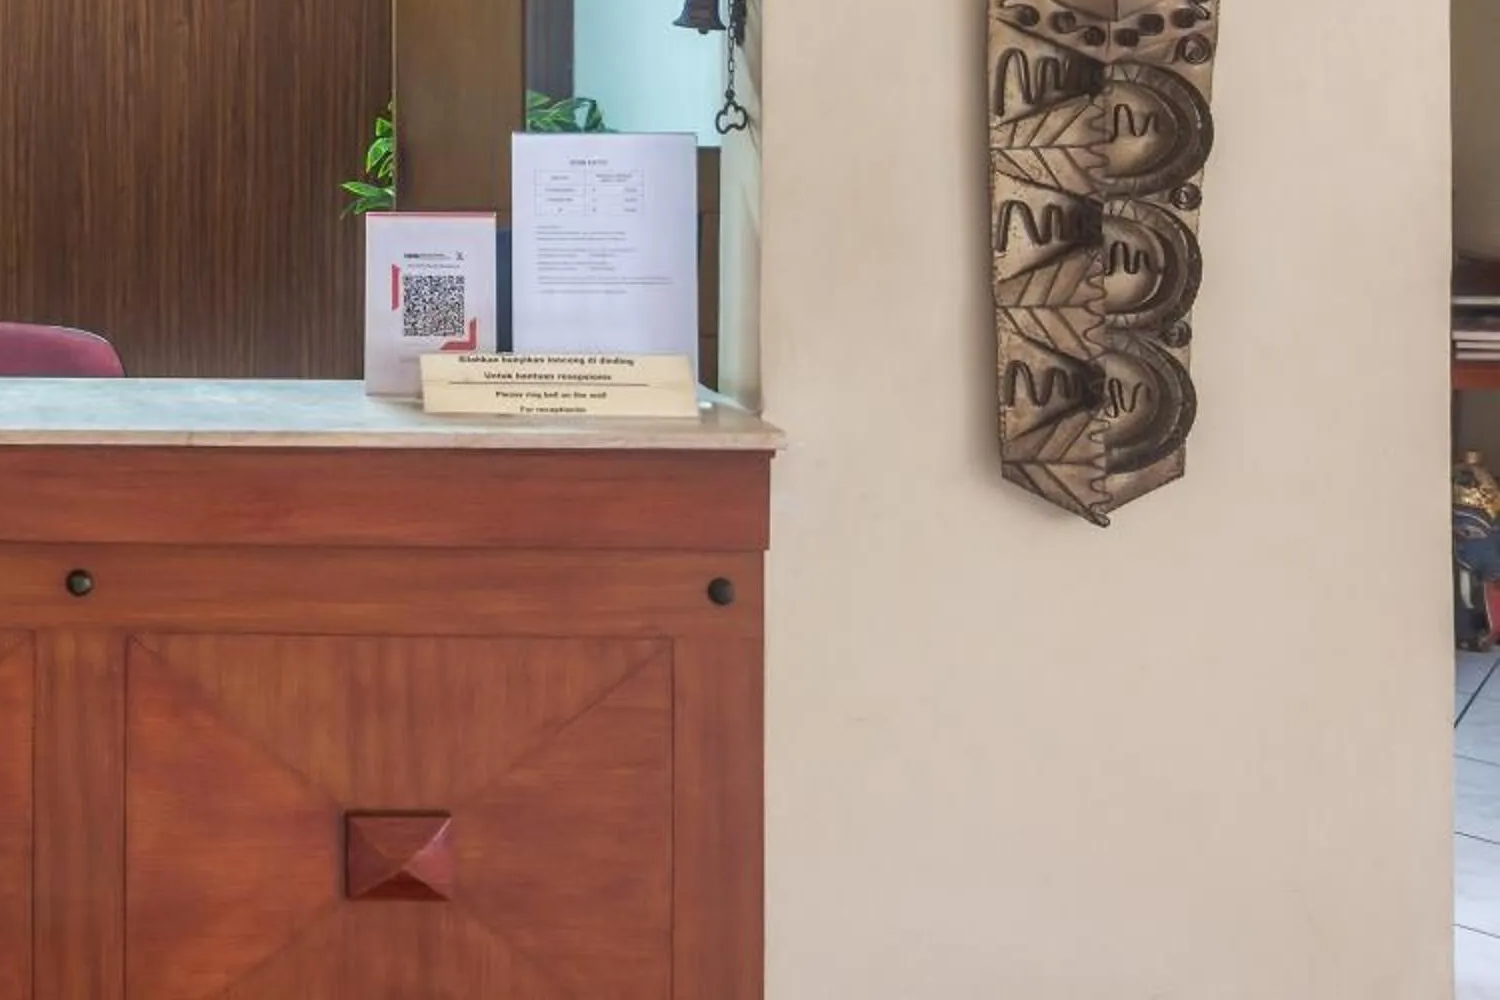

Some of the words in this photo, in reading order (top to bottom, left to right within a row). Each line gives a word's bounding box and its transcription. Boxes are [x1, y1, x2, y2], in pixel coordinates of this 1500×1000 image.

[587, 356, 597, 365] di
[599, 356, 635, 367] dinding
[483, 371, 513, 380] Untuk
[515, 371, 555, 380] bantuan
[495, 390, 523, 398] Please
[525, 391, 542, 399] ring
[543, 391, 559, 399] bell
[573, 391, 587, 399] the
[589, 391, 607, 399] wall
